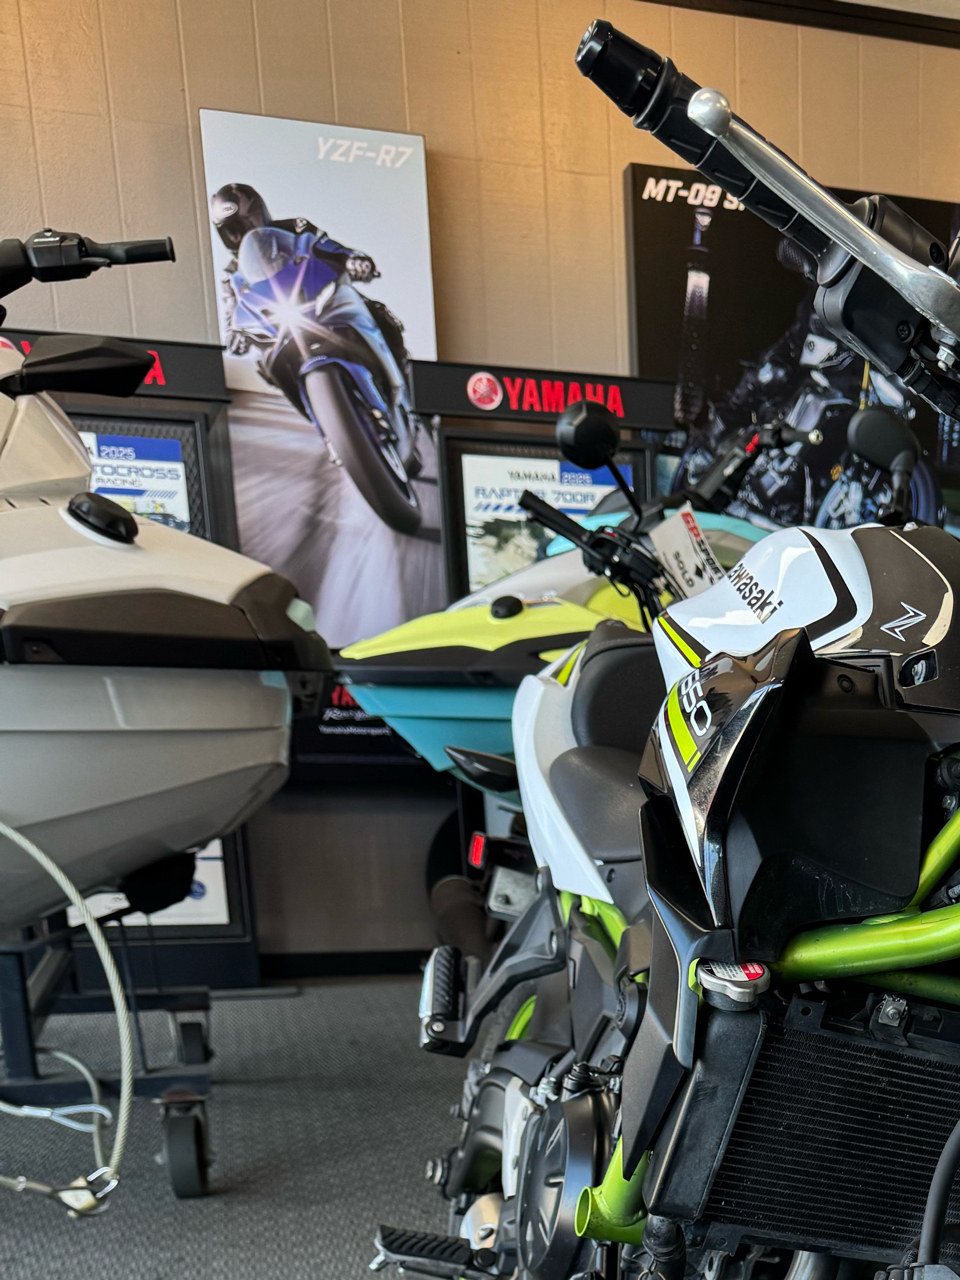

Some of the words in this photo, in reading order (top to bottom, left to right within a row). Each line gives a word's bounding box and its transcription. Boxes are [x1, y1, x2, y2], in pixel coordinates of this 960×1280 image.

[317, 136, 414, 168] YZF-R7
[641, 177, 723, 208] MT-09
[722, 191, 746, 212] S
[502, 376, 626, 419] YAMAHA
[100, 445, 136, 460] 2025
[92, 464, 181, 480] TOCROSS
[474, 486, 547, 501] RAPTR
[551, 489, 596, 504] 700R
[672, 551, 696, 589] SOLD
[727, 562, 785, 625] awasaki
